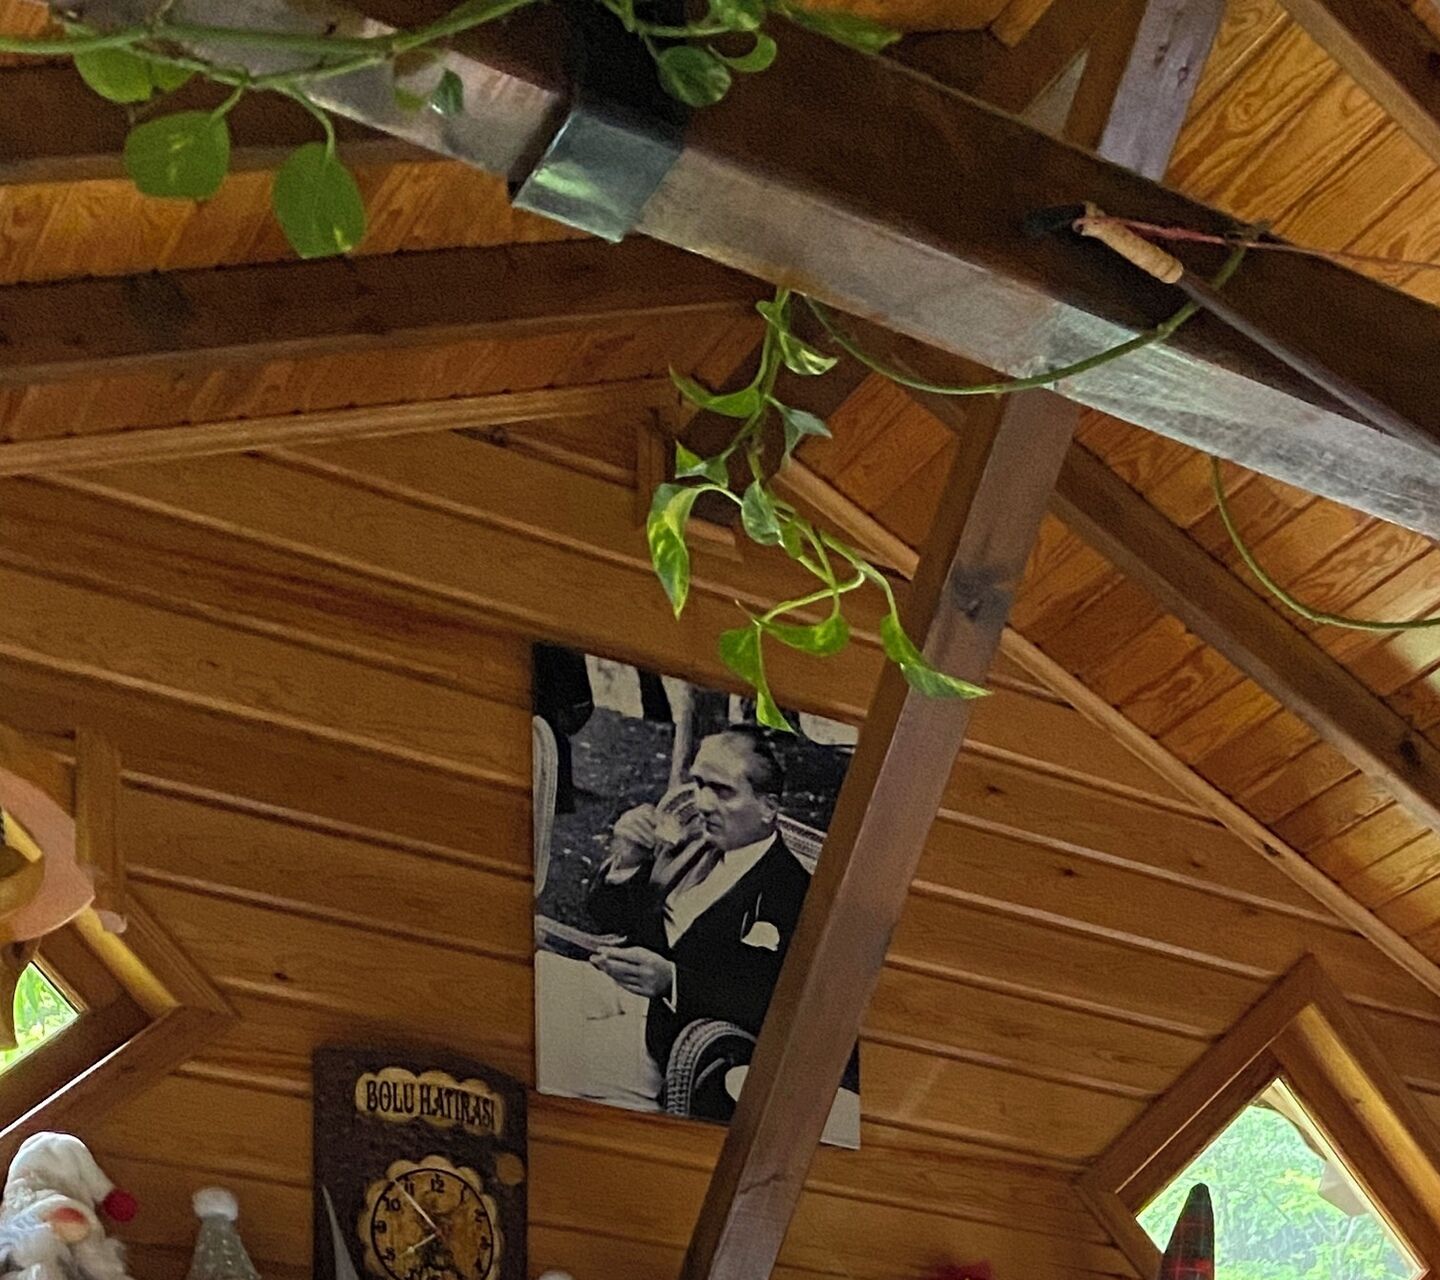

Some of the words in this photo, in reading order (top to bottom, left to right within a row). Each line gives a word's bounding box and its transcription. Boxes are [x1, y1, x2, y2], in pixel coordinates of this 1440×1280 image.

[366, 1080, 415, 1114] BOLU
[420, 1084, 495, 1130] HATIRASI
[431, 1177, 446, 1194] 12
[386, 1197, 402, 1212] 10
